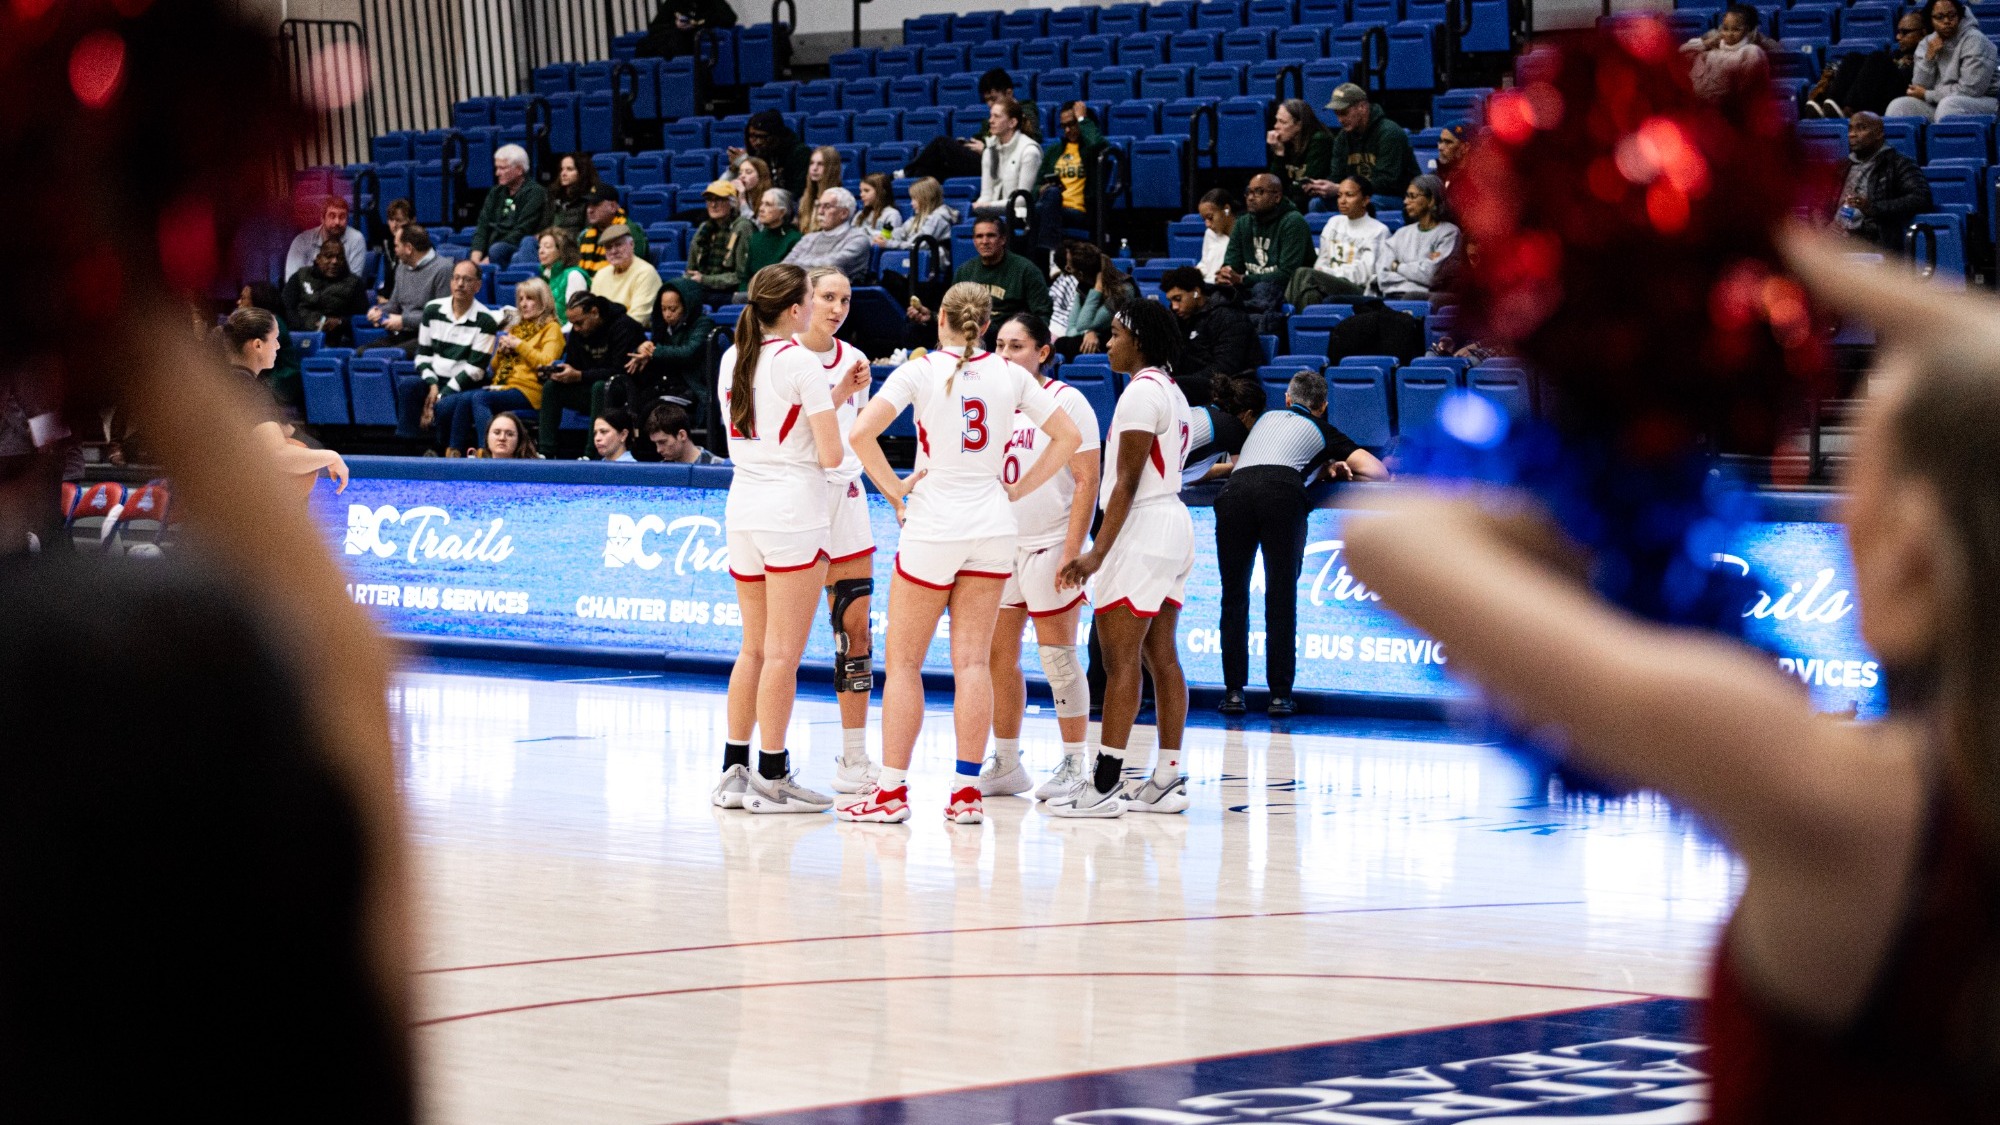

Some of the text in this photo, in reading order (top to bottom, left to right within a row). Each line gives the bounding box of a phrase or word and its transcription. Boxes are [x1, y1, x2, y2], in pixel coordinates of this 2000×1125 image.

[961, 395, 990, 453] 3
[1010, 428, 1036, 450] CAN
[401, 506, 514, 563] Trails
[667, 515, 730, 576] Tra
[403, 586, 439, 609] BUS
[441, 588, 529, 614] SERVICES
[576, 595, 667, 622] CHARTER
[670, 599, 710, 624] BUS
[1305, 633, 1354, 661] BUS
[1359, 636, 1448, 664] SERVIC
